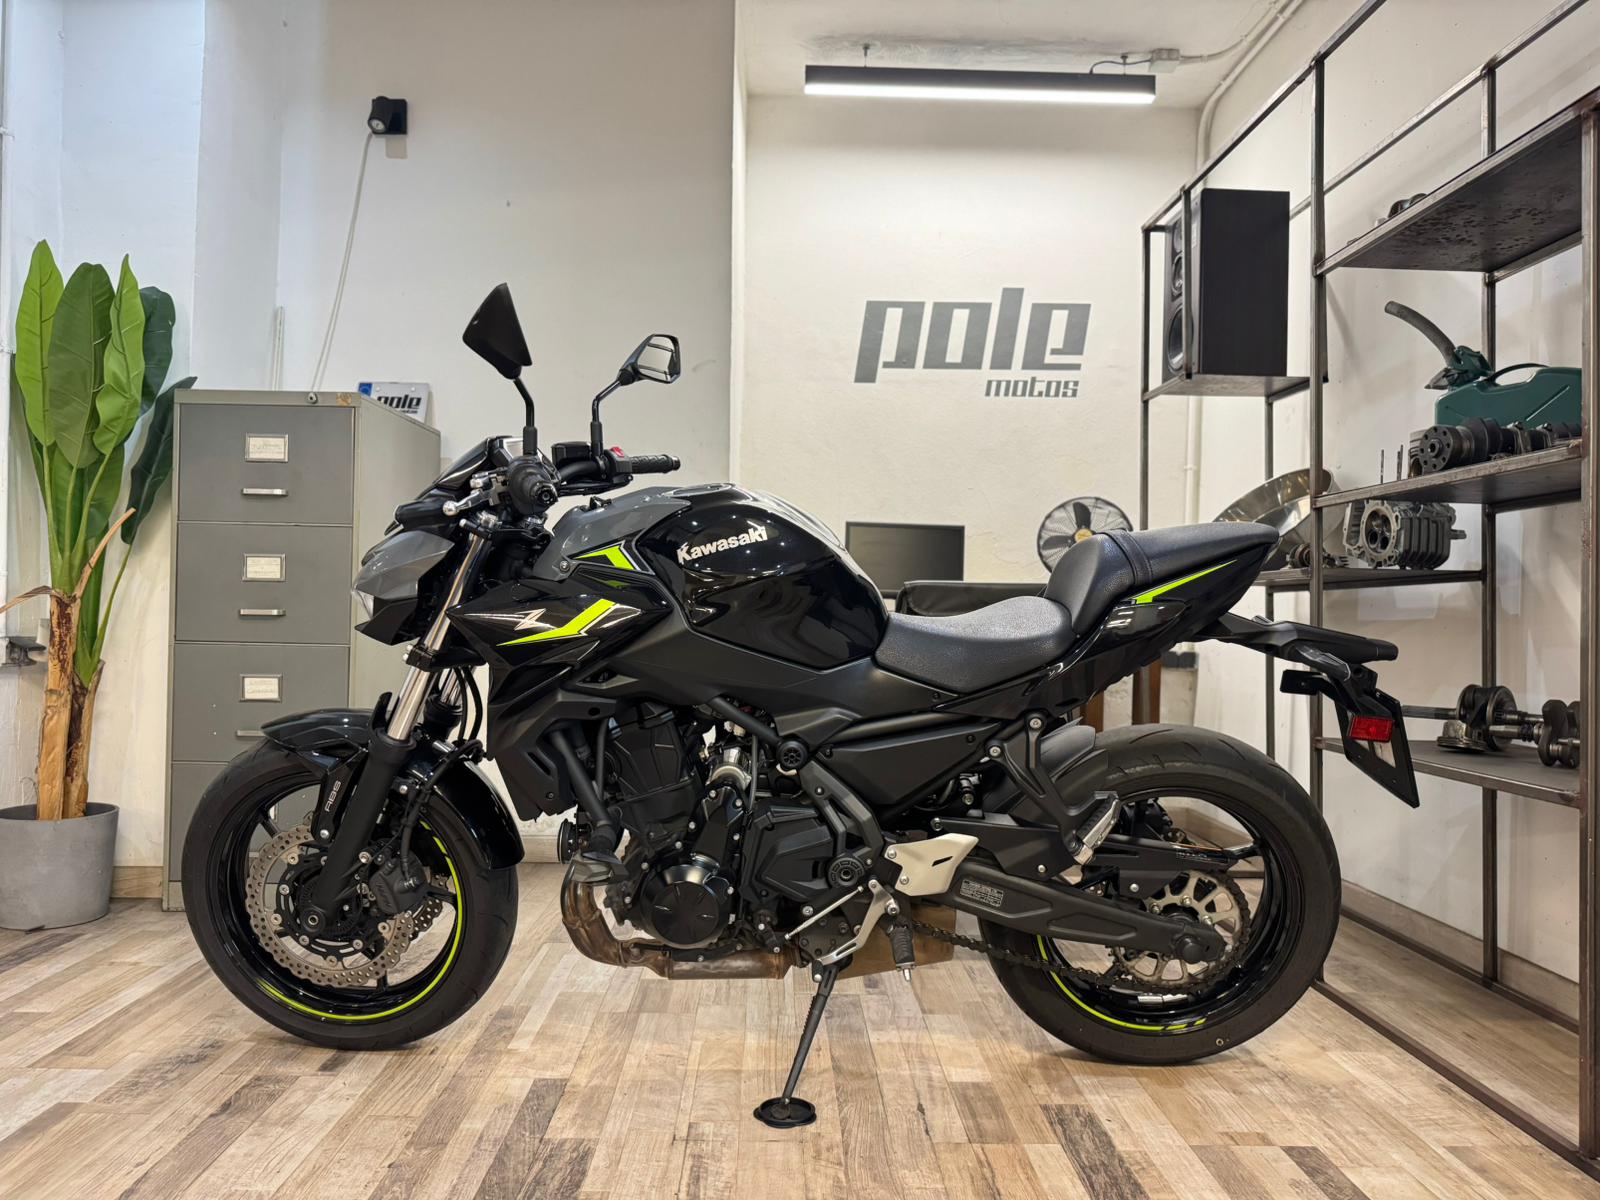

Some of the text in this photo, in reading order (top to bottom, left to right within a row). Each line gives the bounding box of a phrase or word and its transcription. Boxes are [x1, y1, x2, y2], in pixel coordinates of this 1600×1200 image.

[854, 287, 1092, 384] pole
[984, 376, 1080, 398] motos
[676, 520, 768, 565] Kawasaki
[324, 780, 342, 812] ABS
